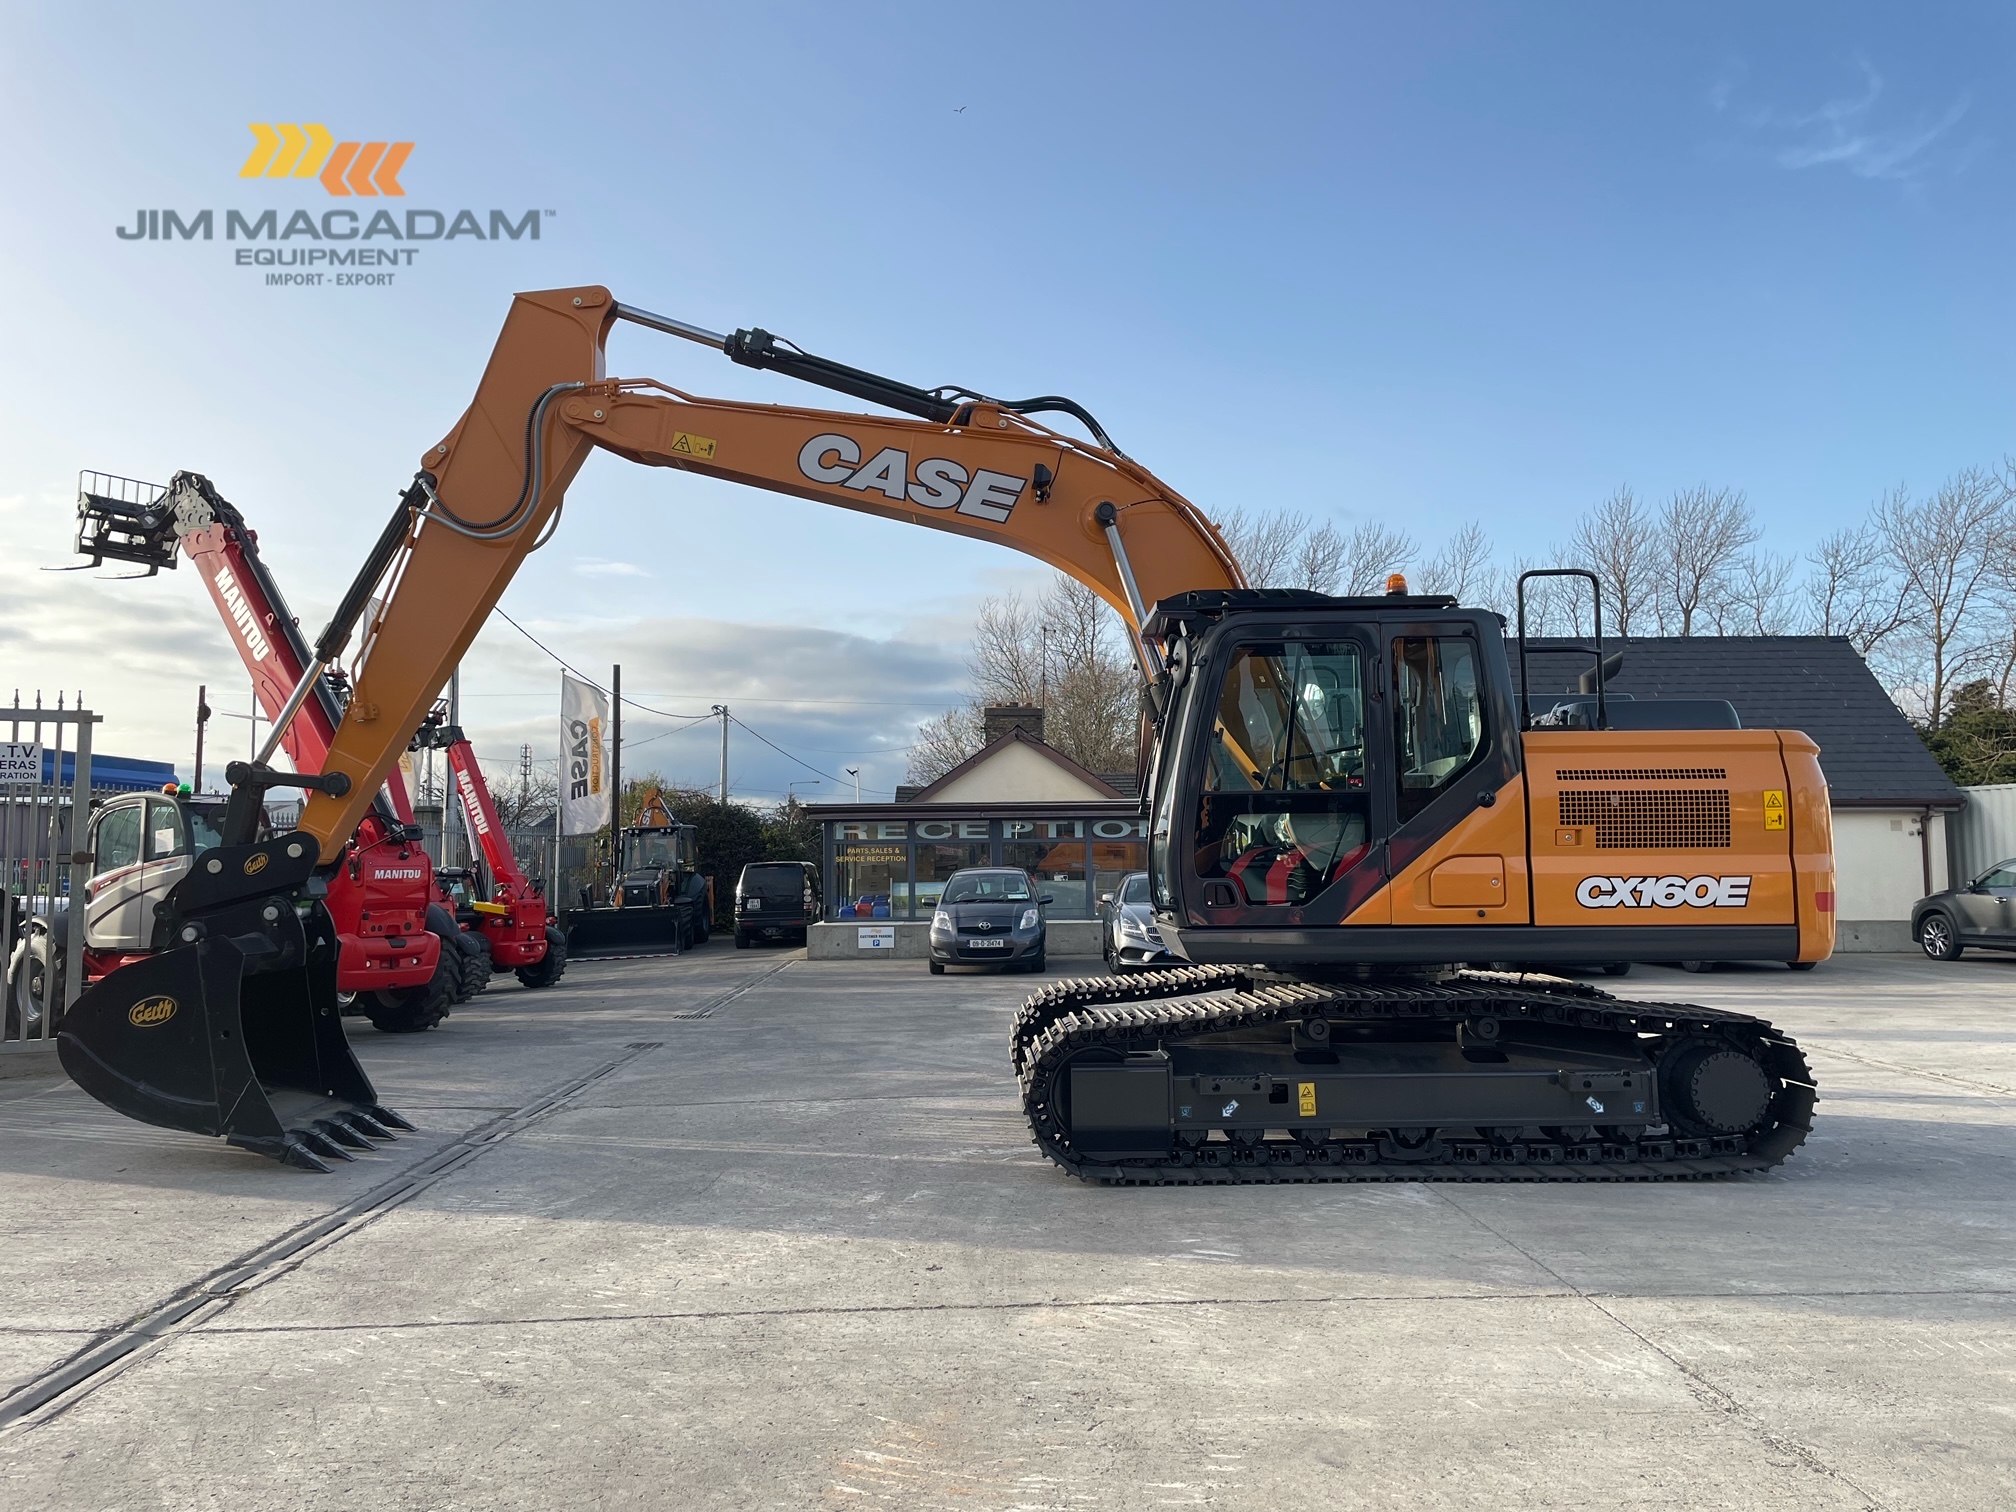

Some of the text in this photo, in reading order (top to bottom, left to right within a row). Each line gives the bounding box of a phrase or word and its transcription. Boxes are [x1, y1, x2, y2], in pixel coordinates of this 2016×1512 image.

[797, 432, 1028, 524] CASE
[214, 565, 270, 662] MANITOU
[457, 768, 490, 835] MANITOU
[835, 821, 1148, 840] RECEPTIO
[374, 869, 421, 880] MANITOU
[1576, 874, 1752, 909] CX160E
